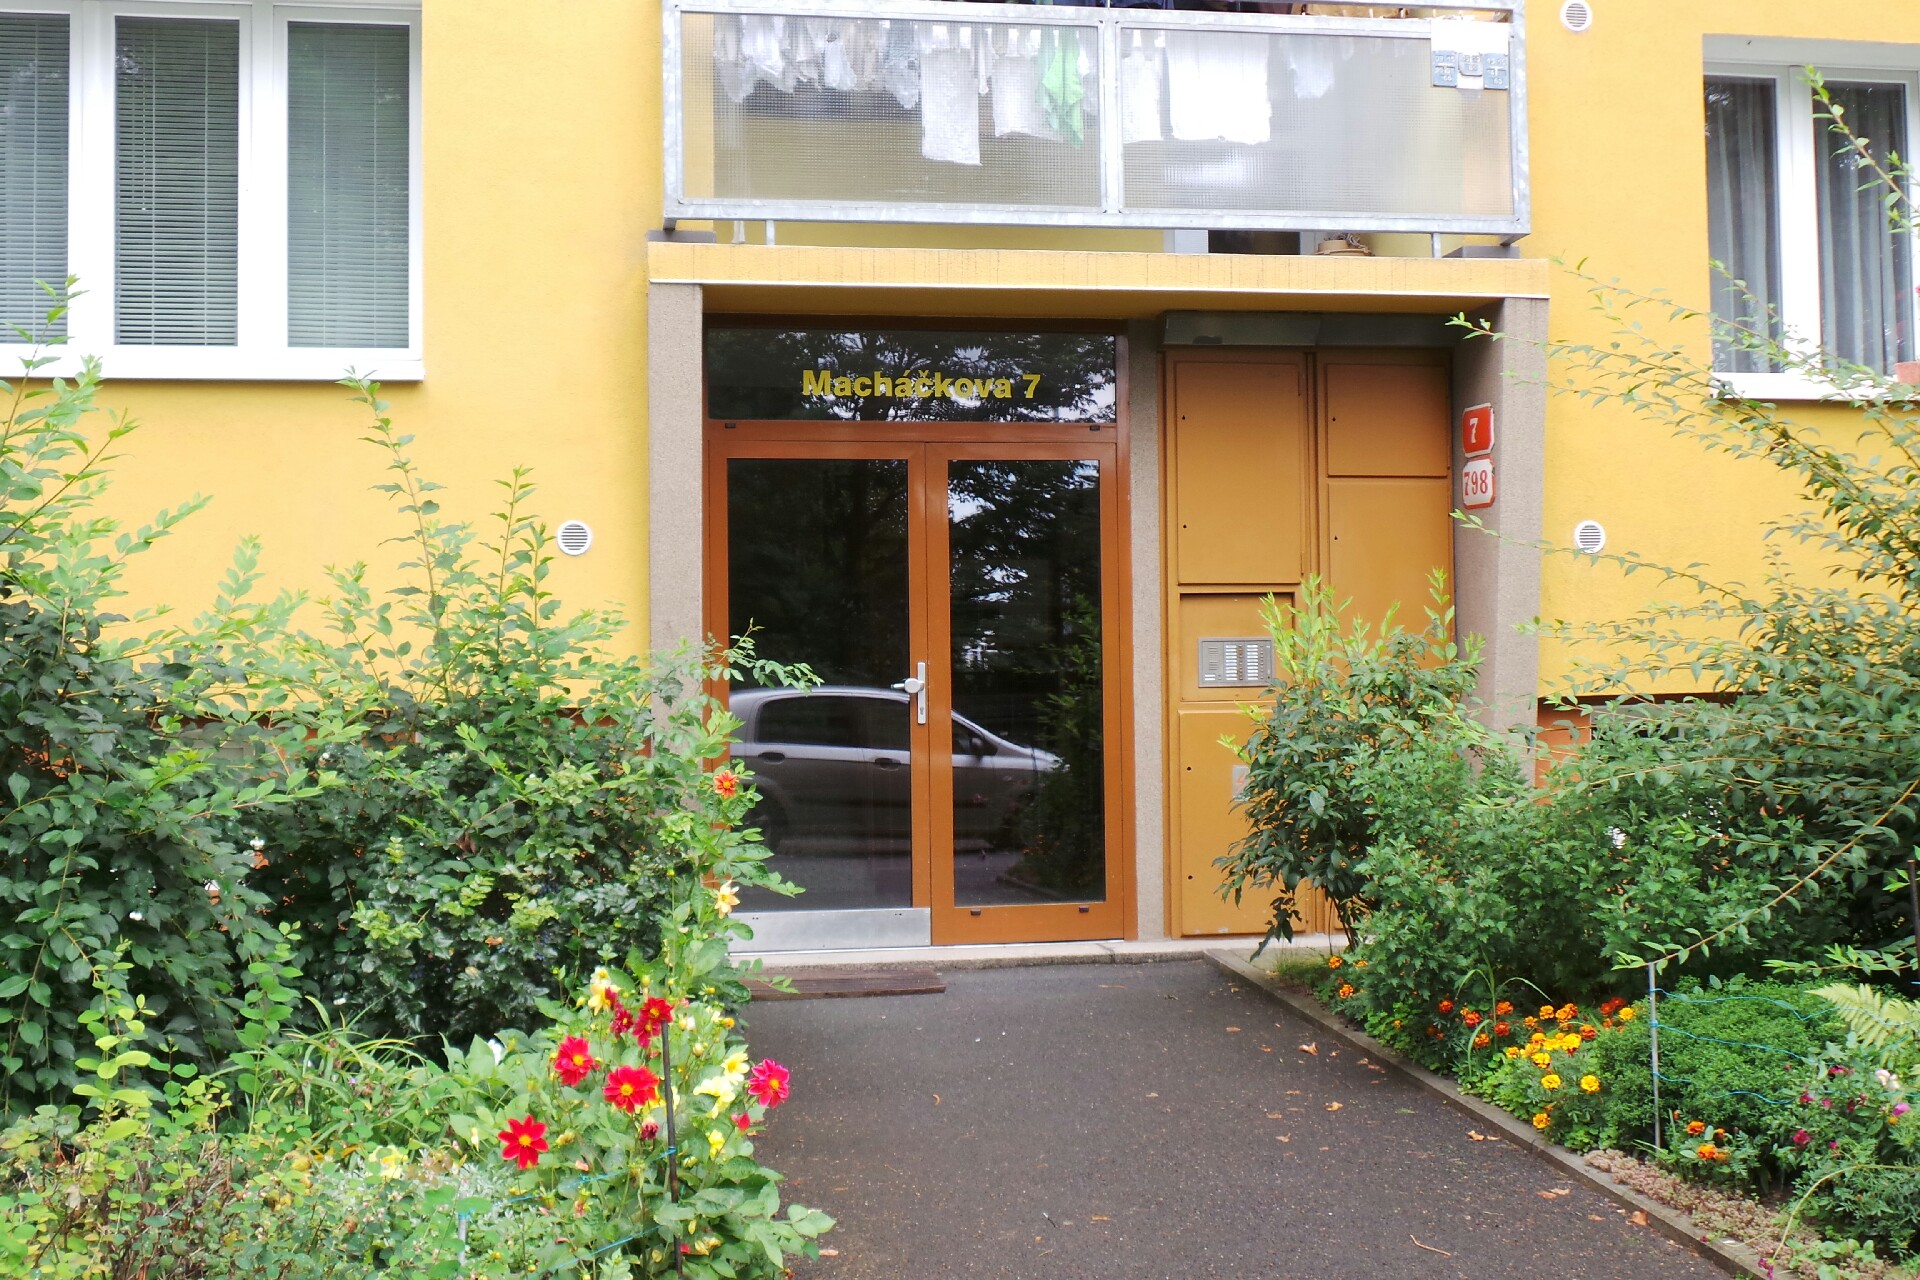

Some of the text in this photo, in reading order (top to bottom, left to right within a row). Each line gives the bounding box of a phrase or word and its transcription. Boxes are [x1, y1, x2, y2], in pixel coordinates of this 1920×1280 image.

[802, 369, 1041, 399] Macháčkova 7
[1469, 417, 1479, 444] 7
[1463, 469, 1489, 496] 798
